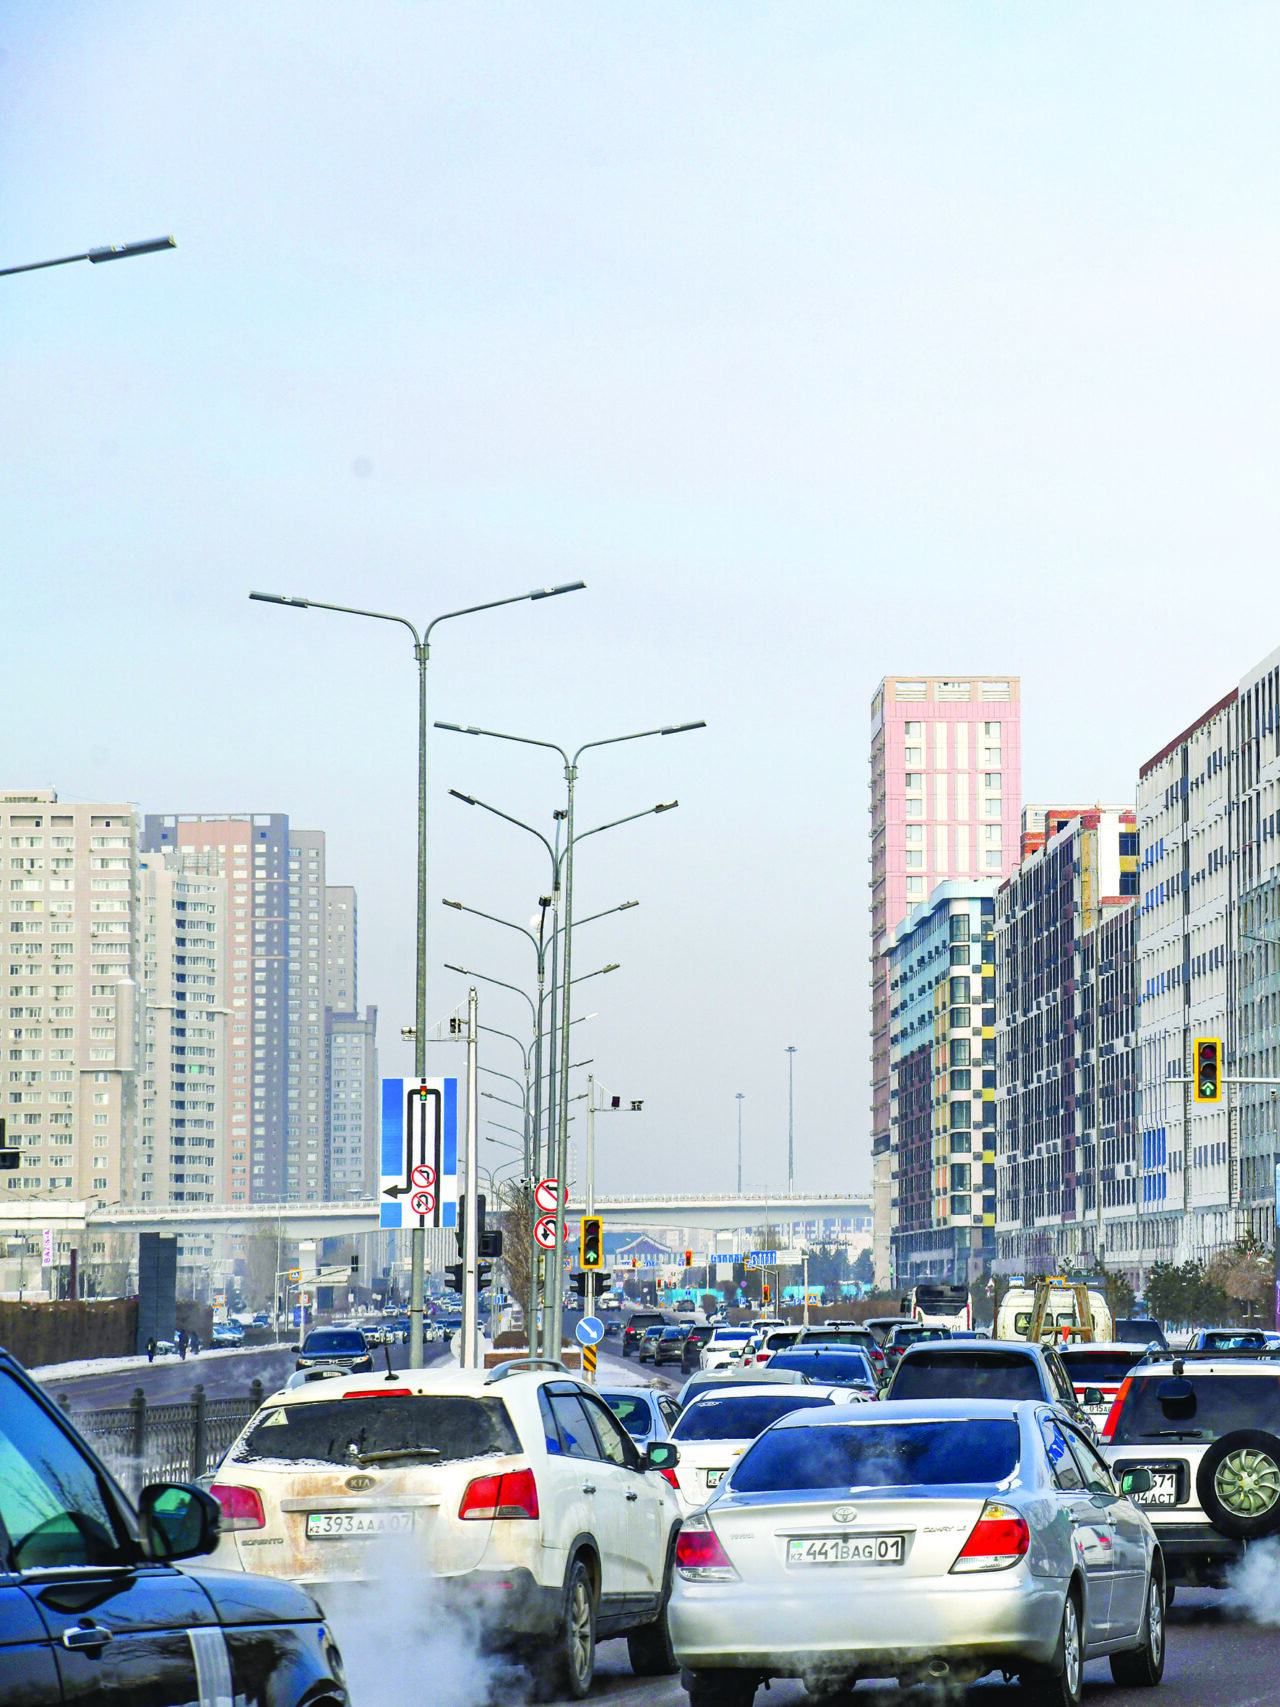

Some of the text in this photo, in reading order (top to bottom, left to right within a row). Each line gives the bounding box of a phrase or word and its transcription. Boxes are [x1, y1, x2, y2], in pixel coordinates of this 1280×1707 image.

[350, 1478, 370, 1488] KIA
[1150, 1493, 1174, 1504] ACT
[309, 1525, 321, 1534] KZ
[790, 1553, 803, 1561] KZ
[877, 1540, 901, 1558] 01
